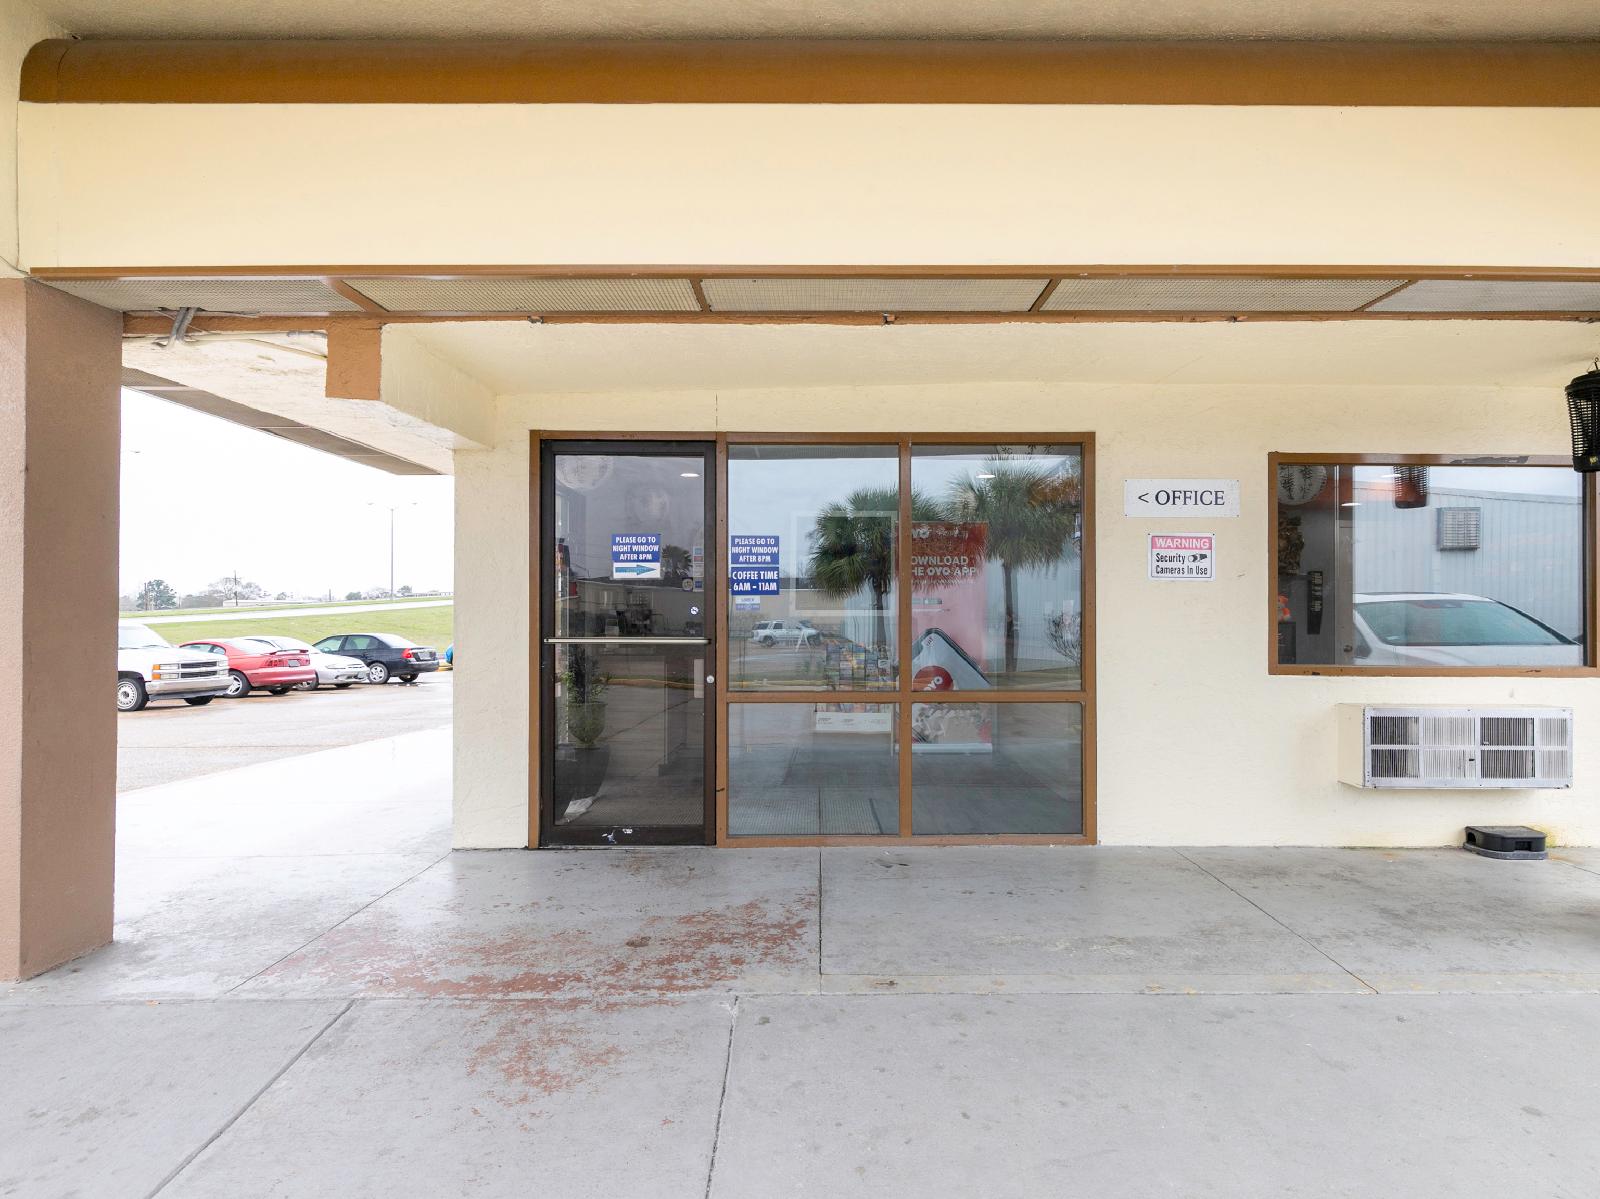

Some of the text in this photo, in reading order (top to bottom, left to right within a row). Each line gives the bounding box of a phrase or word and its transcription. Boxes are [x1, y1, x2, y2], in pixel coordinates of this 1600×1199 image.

[1155, 490, 1225, 506] OFFICE
[615, 536, 656, 544] PLEASE GO TO
[1155, 538, 1210, 549] WARNING
[612, 544, 660, 552] NIGHT WINDOW
[731, 546, 779, 554] NIGHT WINDOW
[619, 553, 653, 561] AFTER 8PM
[738, 555, 772, 563] AFTER 8PM
[912, 556, 969, 565] OWNLOAD
[1155, 552, 1186, 564] Security
[912, 566, 977, 576] HE OYO APP
[1155, 564, 1208, 575] Cameras In Use
[732, 570, 779, 580] COFFEE TIME
[733, 582, 751, 591] 6AM
[758, 582, 777, 591] 11AM
